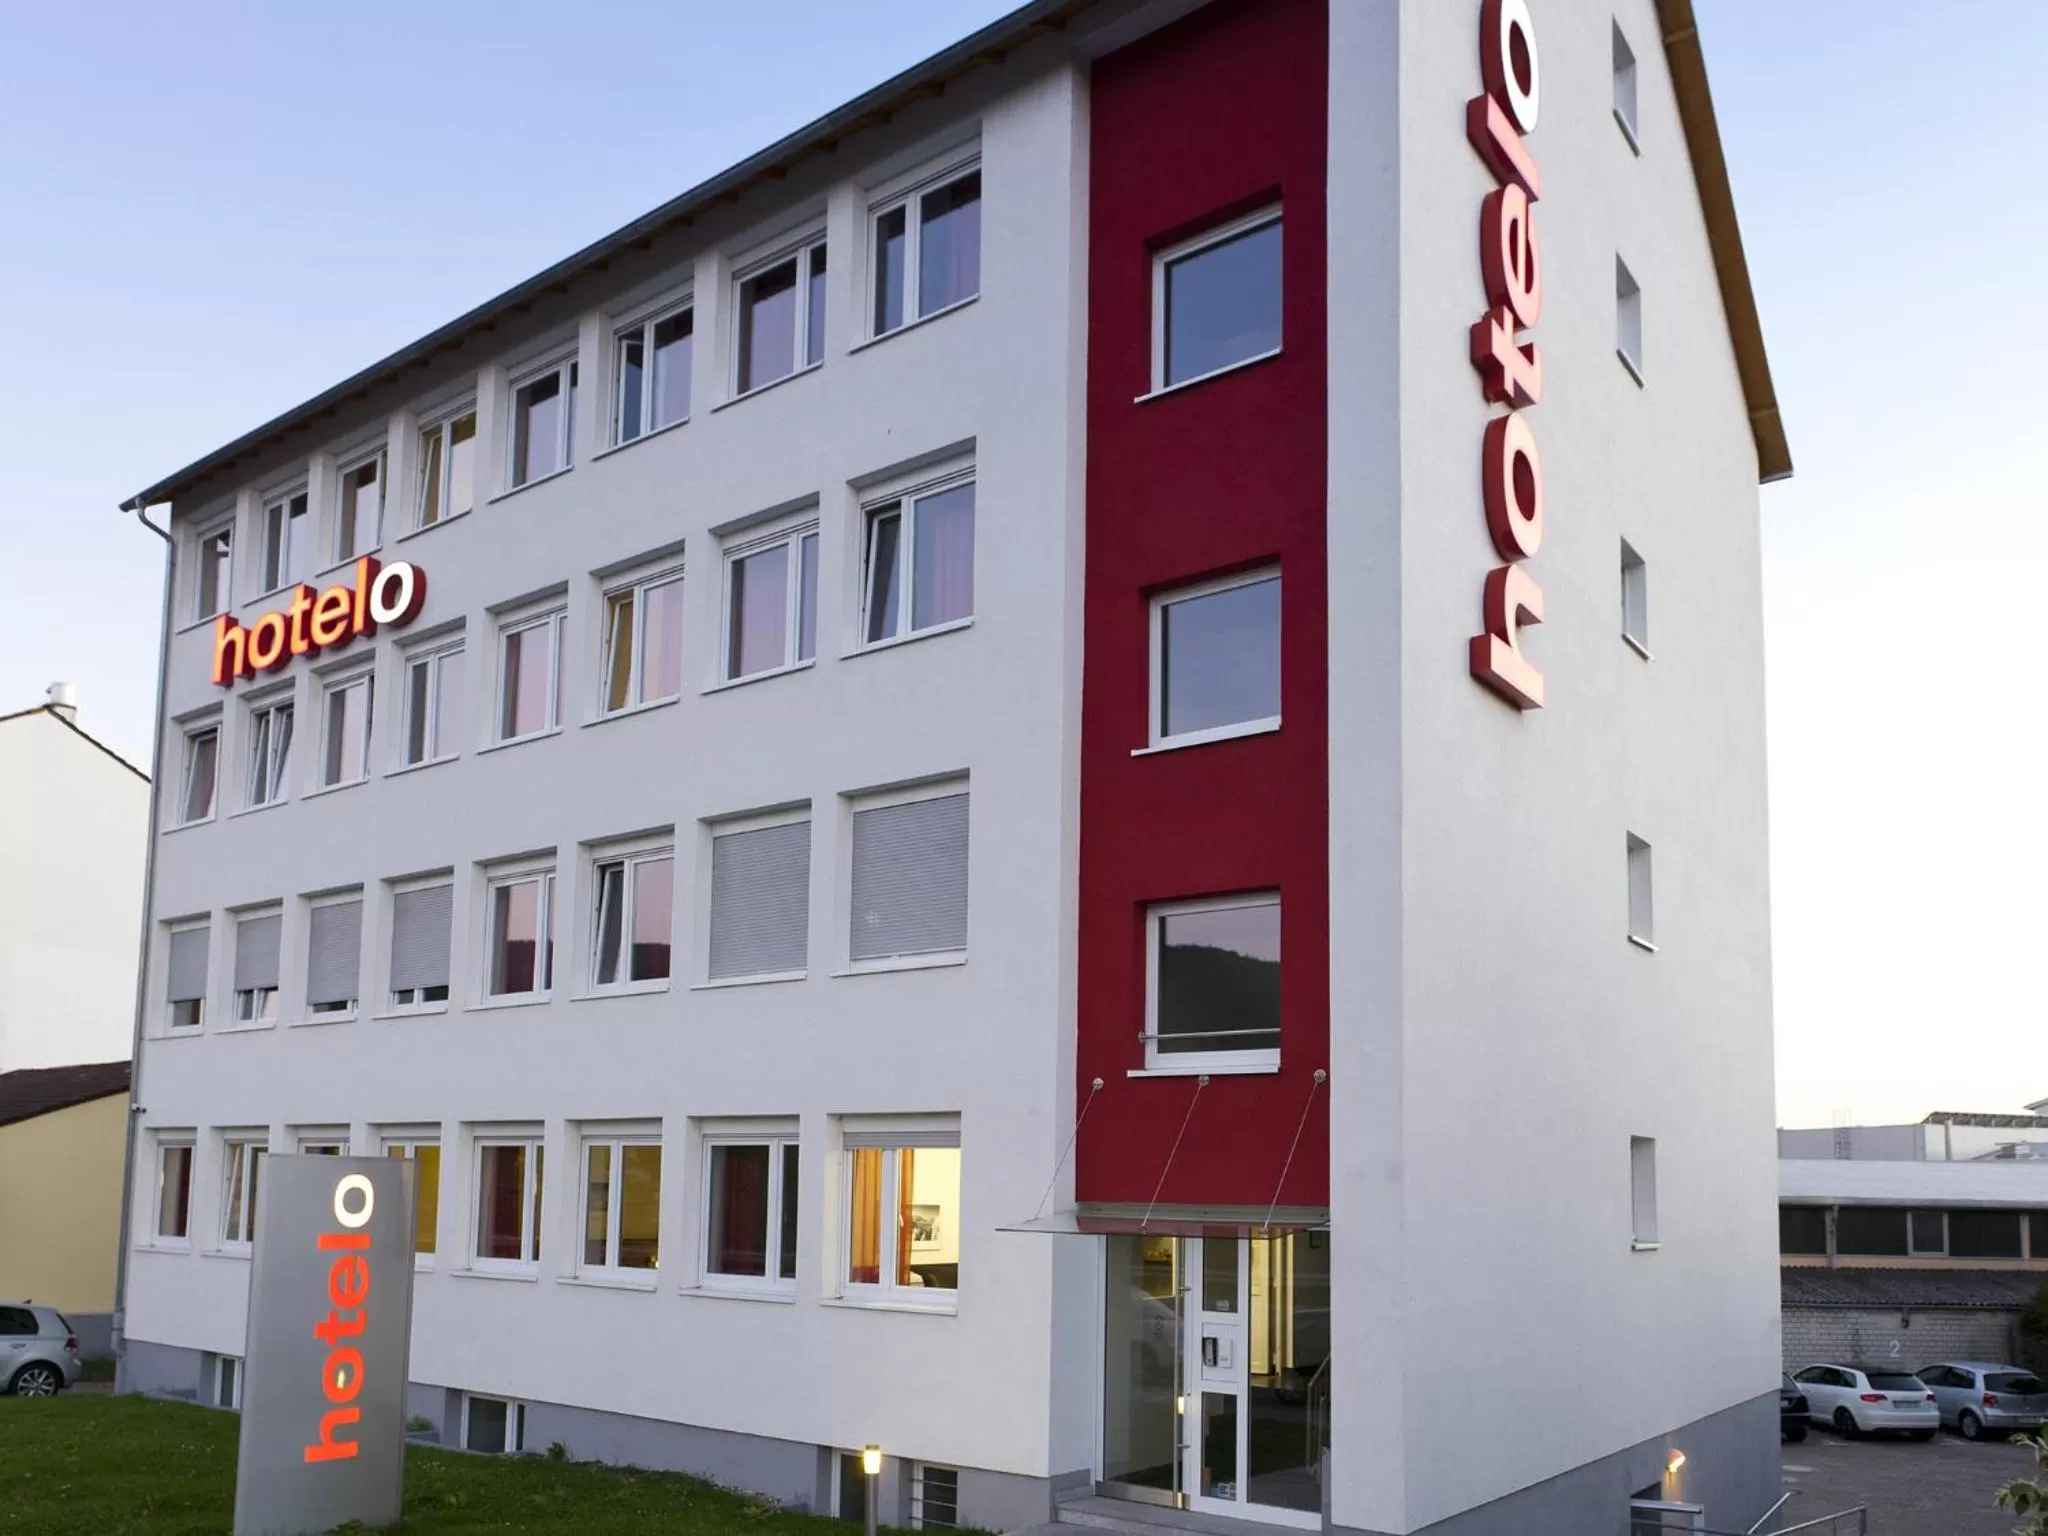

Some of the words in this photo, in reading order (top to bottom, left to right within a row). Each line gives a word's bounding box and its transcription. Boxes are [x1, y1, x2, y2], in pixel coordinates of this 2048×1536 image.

[1468, 0, 1544, 709] hotelo
[212, 555, 424, 687] hotelo
[304, 1173, 375, 1463] hotelo
[1889, 1340, 1901, 1358] 2
